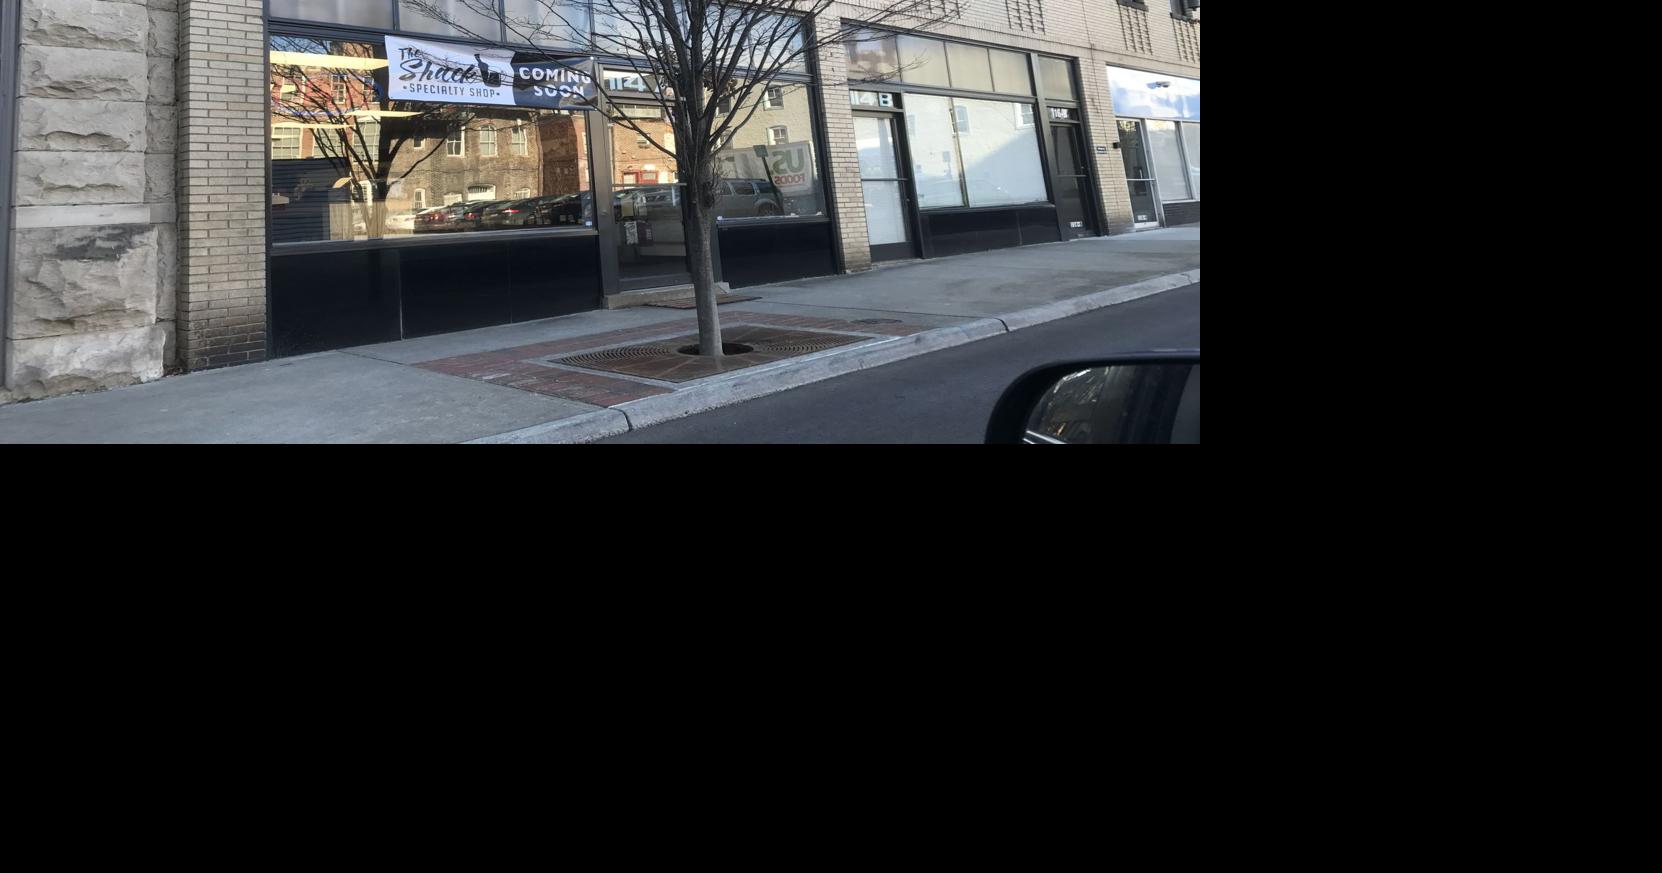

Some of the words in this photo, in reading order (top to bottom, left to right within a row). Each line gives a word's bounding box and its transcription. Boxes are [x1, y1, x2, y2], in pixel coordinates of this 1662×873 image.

[399, 47, 422, 60] The
[399, 58, 478, 83] Shack
[519, 67, 591, 83] COMING
[409, 83, 464, 96] SPECIALTY
[469, 87, 495, 98] SHOP
[533, 84, 584, 98] SOON
